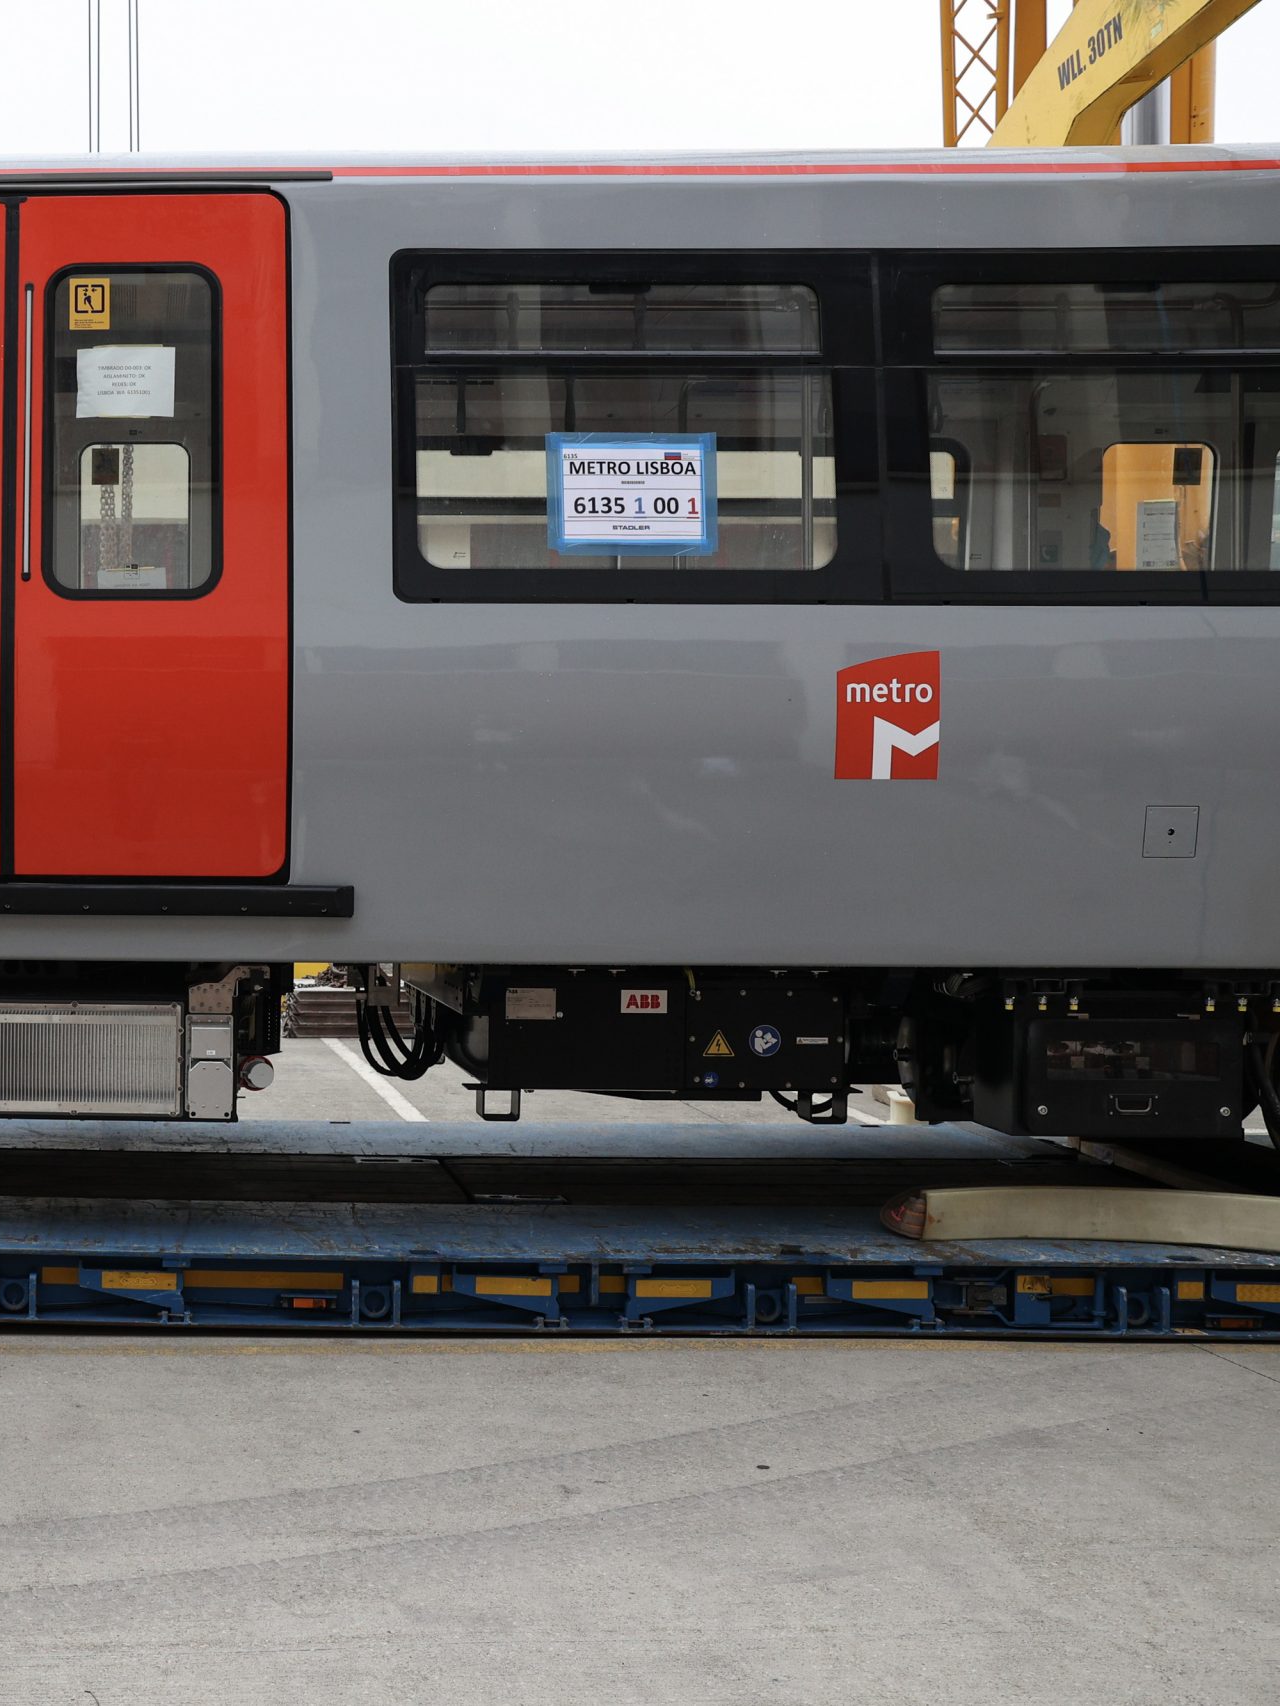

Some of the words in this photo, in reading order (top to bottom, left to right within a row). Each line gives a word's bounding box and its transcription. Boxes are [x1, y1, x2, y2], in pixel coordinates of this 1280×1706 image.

[1057, 48, 1087, 91] WLL.
[1087, 11, 1123, 65] 30TN
[569, 461, 631, 475] METRO
[636, 461, 697, 475] LISBOA
[573, 497, 626, 515] 6135
[634, 497, 646, 515] 1
[653, 497, 680, 515] 00
[686, 497, 699, 515] 1
[846, 677, 933, 703] metro
[625, 994, 661, 1009] ABB
